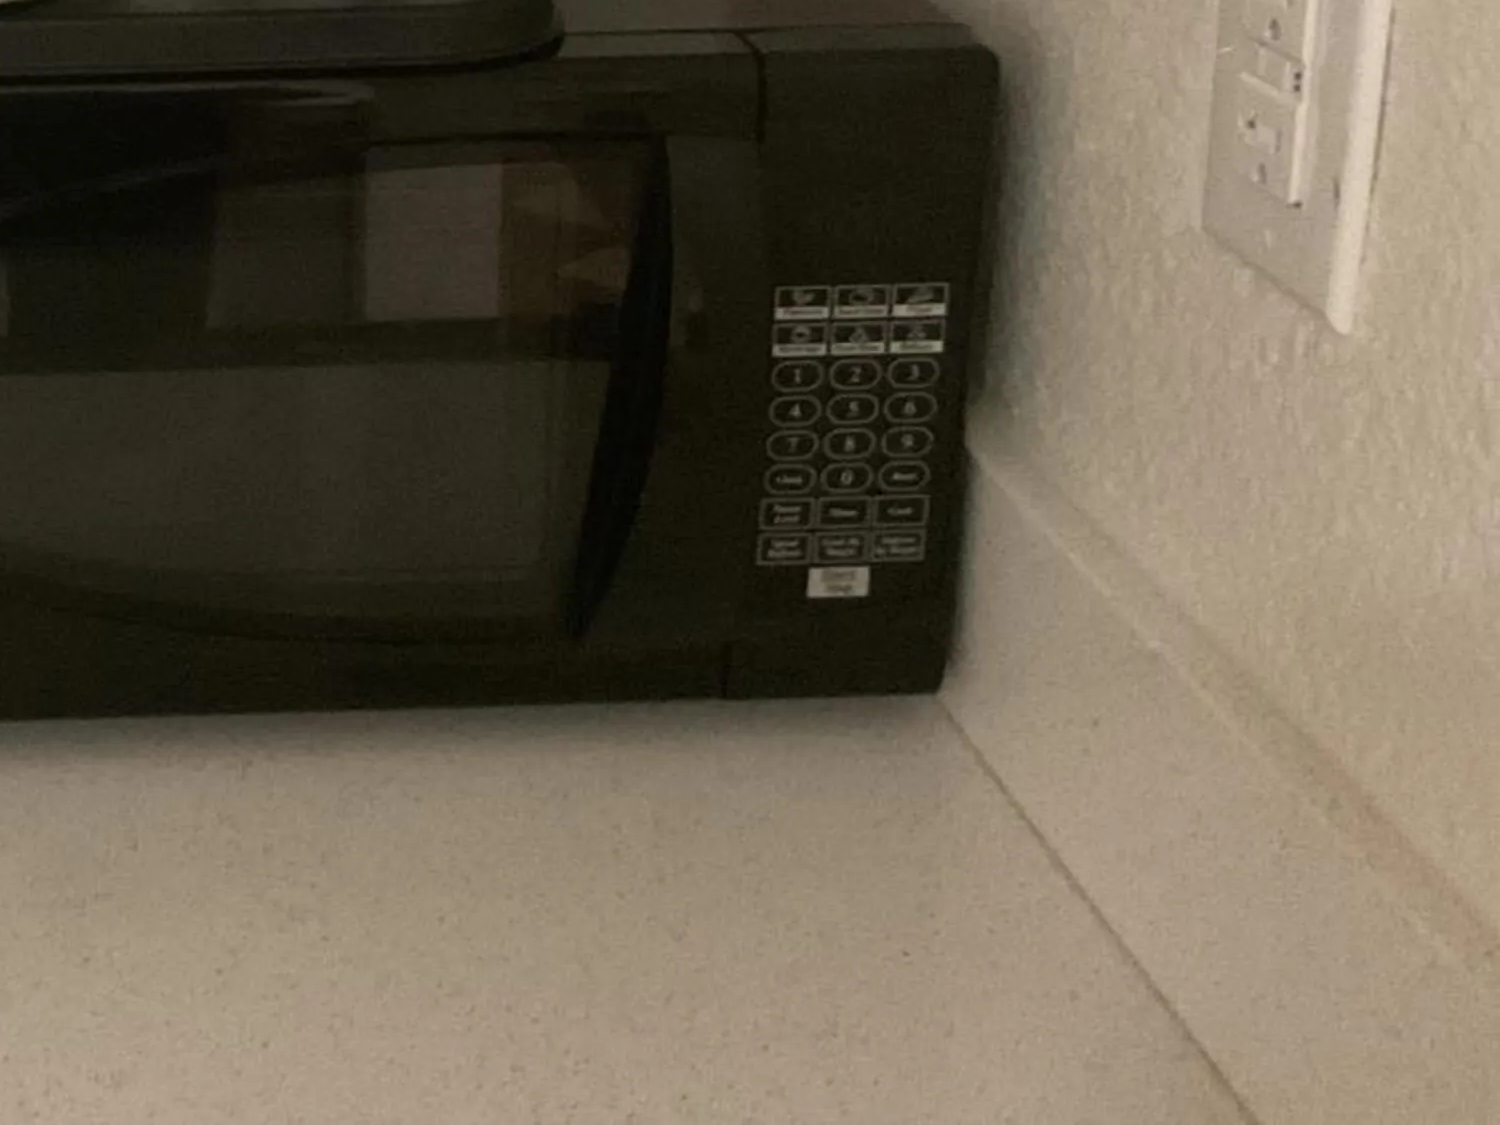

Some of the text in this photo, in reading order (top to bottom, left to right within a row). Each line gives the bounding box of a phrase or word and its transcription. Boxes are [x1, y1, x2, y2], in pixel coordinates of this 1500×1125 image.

[792, 363, 921, 385] 1 2 3
[788, 402, 802, 420] 4
